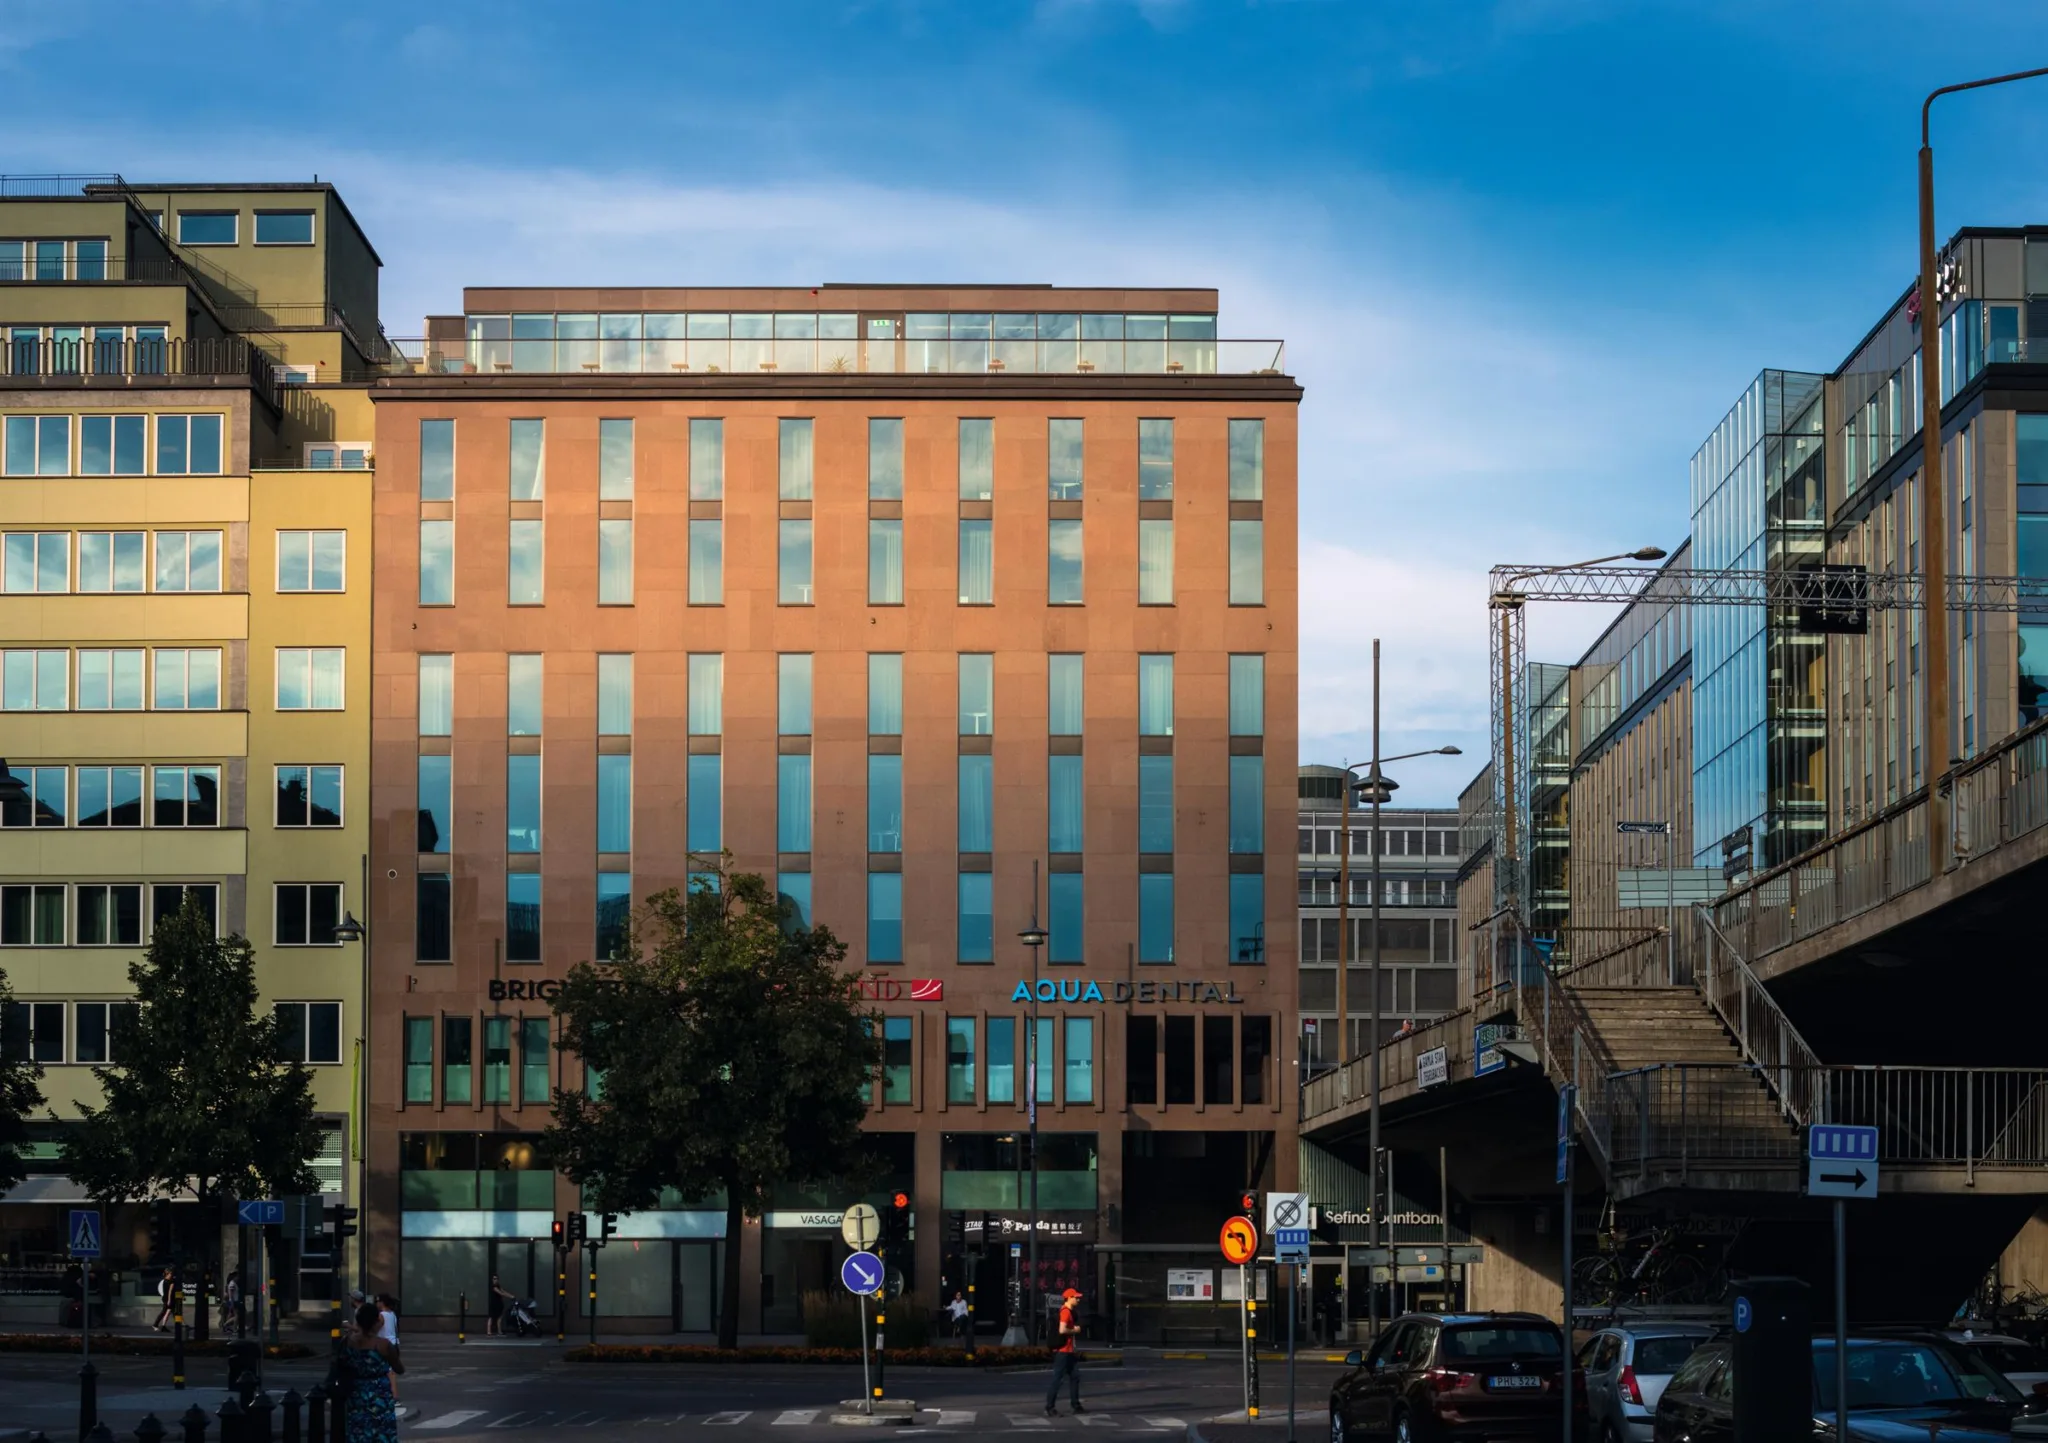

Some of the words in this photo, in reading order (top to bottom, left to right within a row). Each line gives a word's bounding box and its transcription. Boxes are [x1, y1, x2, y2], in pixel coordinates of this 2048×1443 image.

[1011, 978, 1105, 1003] AQUA
[1112, 979, 1244, 1003] DENTAL
[267, 1206, 277, 1219] P
[800, 1214, 844, 1225] VASAGA
[1325, 1210, 1370, 1225] Sefina
[1737, 1304, 1747, 1325] P
[1497, 1376, 1517, 1387] PHL
[1518, 1376, 1536, 1387] 322
